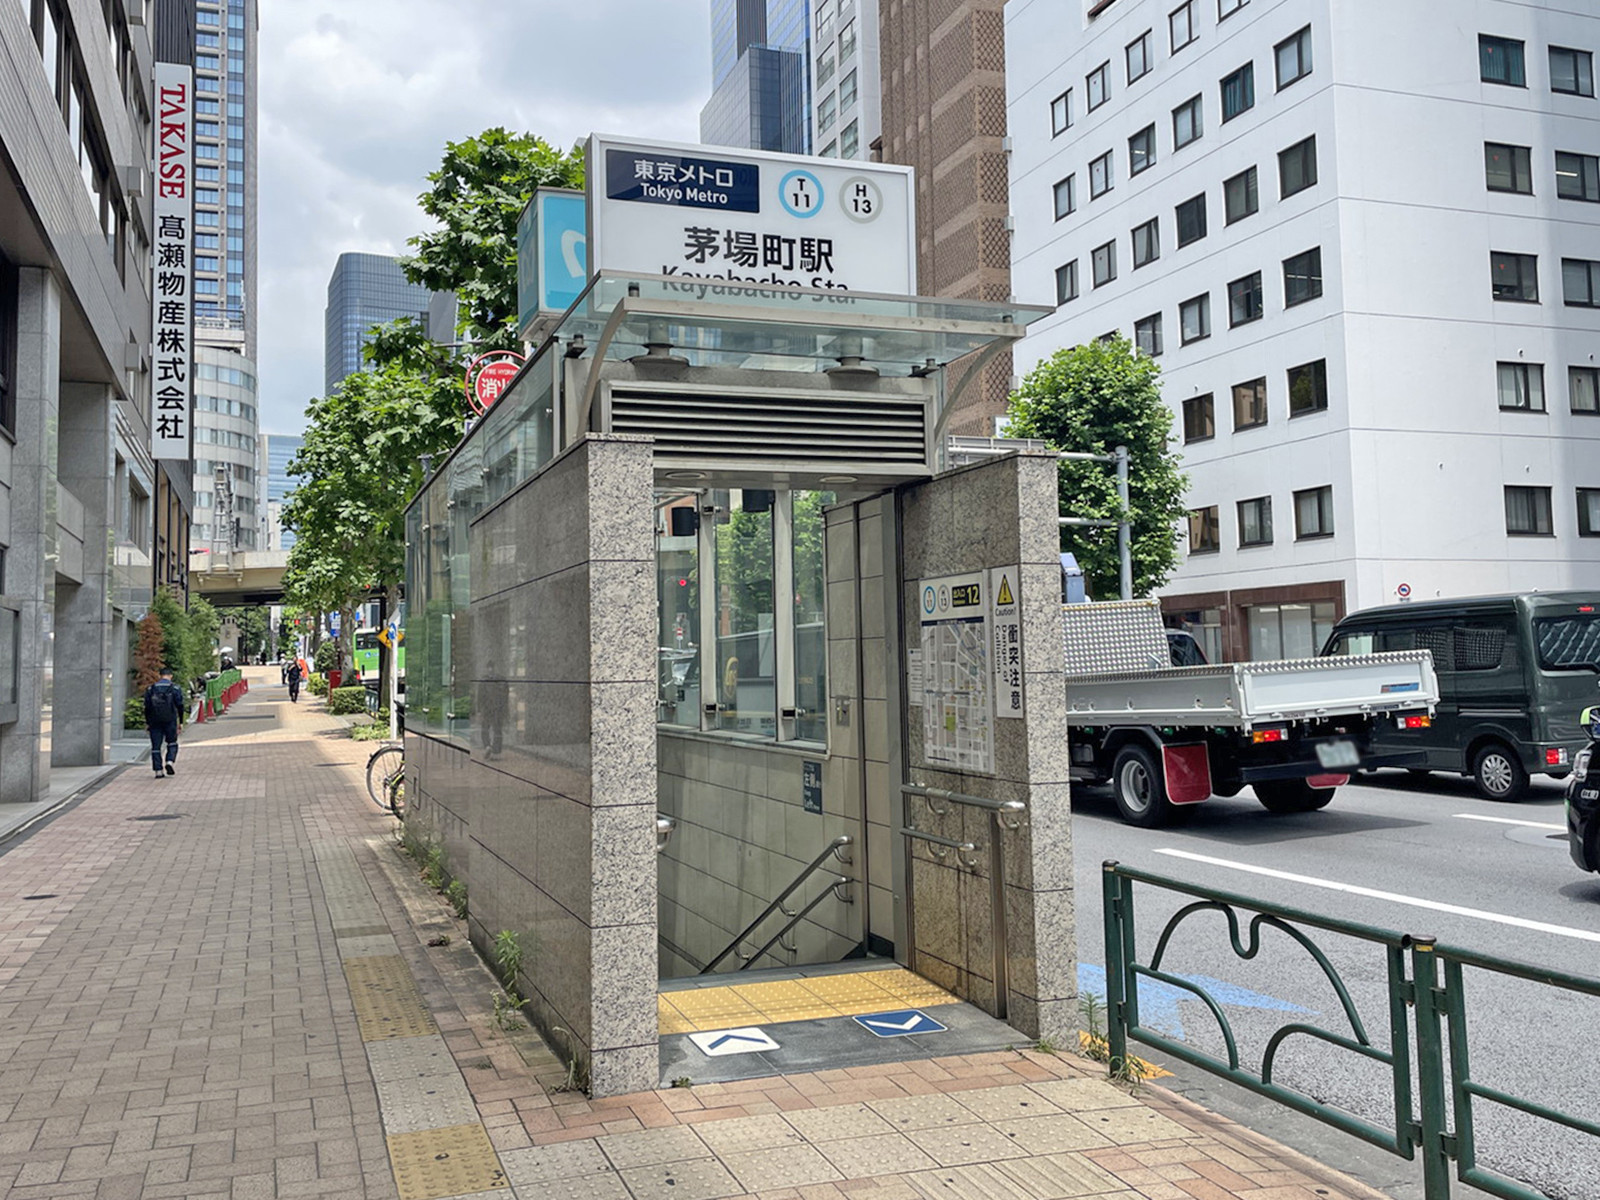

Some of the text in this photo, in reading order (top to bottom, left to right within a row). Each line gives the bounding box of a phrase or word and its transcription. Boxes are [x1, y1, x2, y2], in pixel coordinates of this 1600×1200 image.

[159, 83, 186, 199] TAKASE
[633, 159, 733, 188] 東京メトロ
[640, 182, 728, 204] Tokyo Metro
[797, 178, 806, 191] T
[856, 184, 867, 197] H
[793, 193, 810, 208] 11
[853, 199, 872, 214] 13
[684, 226, 834, 274] 茅場町駅
[967, 585, 979, 604] 12
[1008, 624, 1021, 710] 衝突注意
